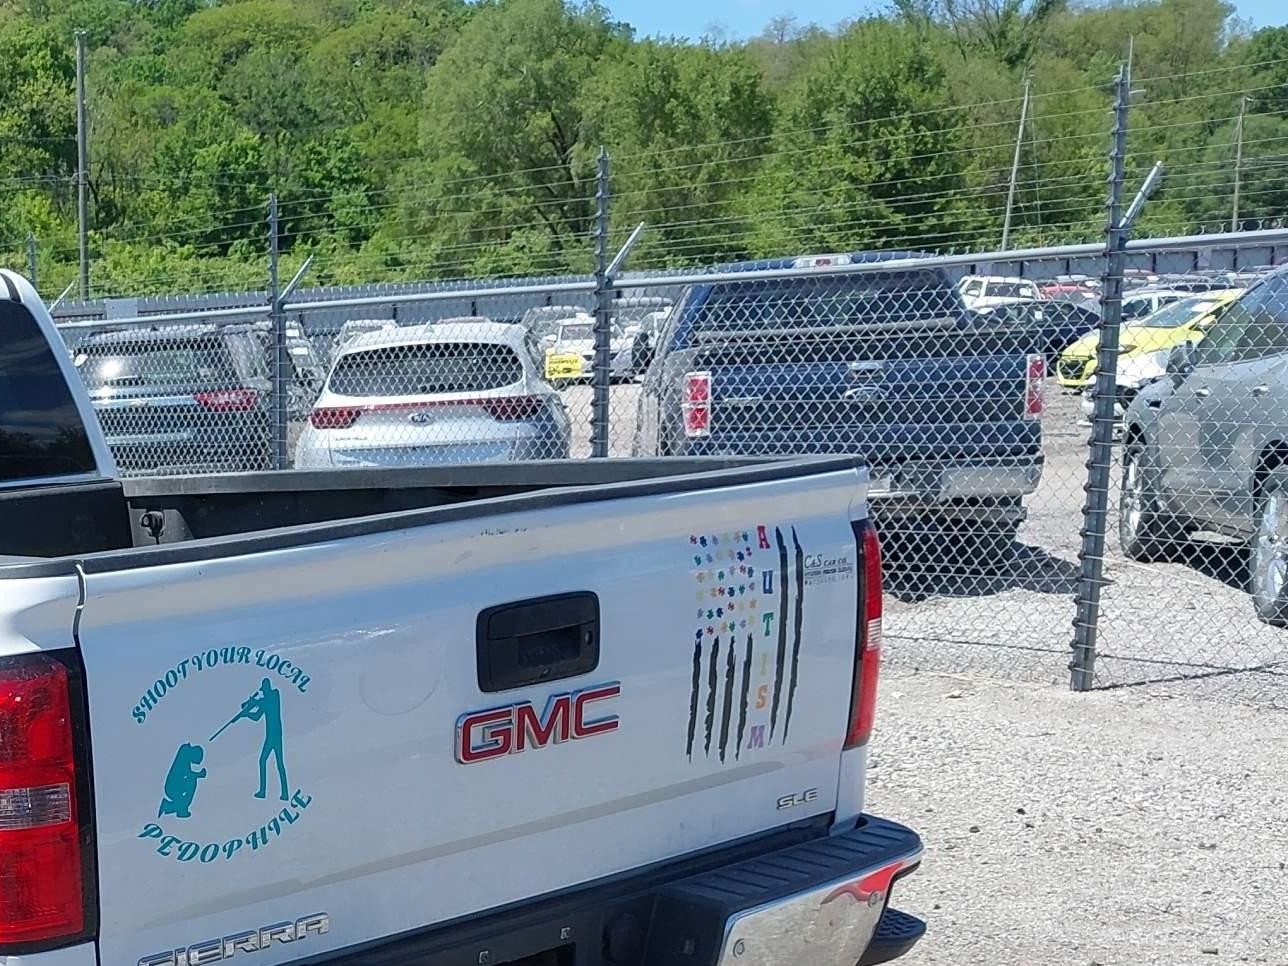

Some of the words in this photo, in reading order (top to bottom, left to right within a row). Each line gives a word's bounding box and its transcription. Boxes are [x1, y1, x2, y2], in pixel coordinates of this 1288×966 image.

[746, 525, 774, 750] AUTISM
[132, 659, 190, 724] SHOOT
[191, 646, 252, 671] YOUR
[255, 649, 312, 693] LOCAL
[453, 680, 621, 765] GMC
[137, 789, 312, 862] PEDOPHILE
[776, 787, 818, 810] SLE
